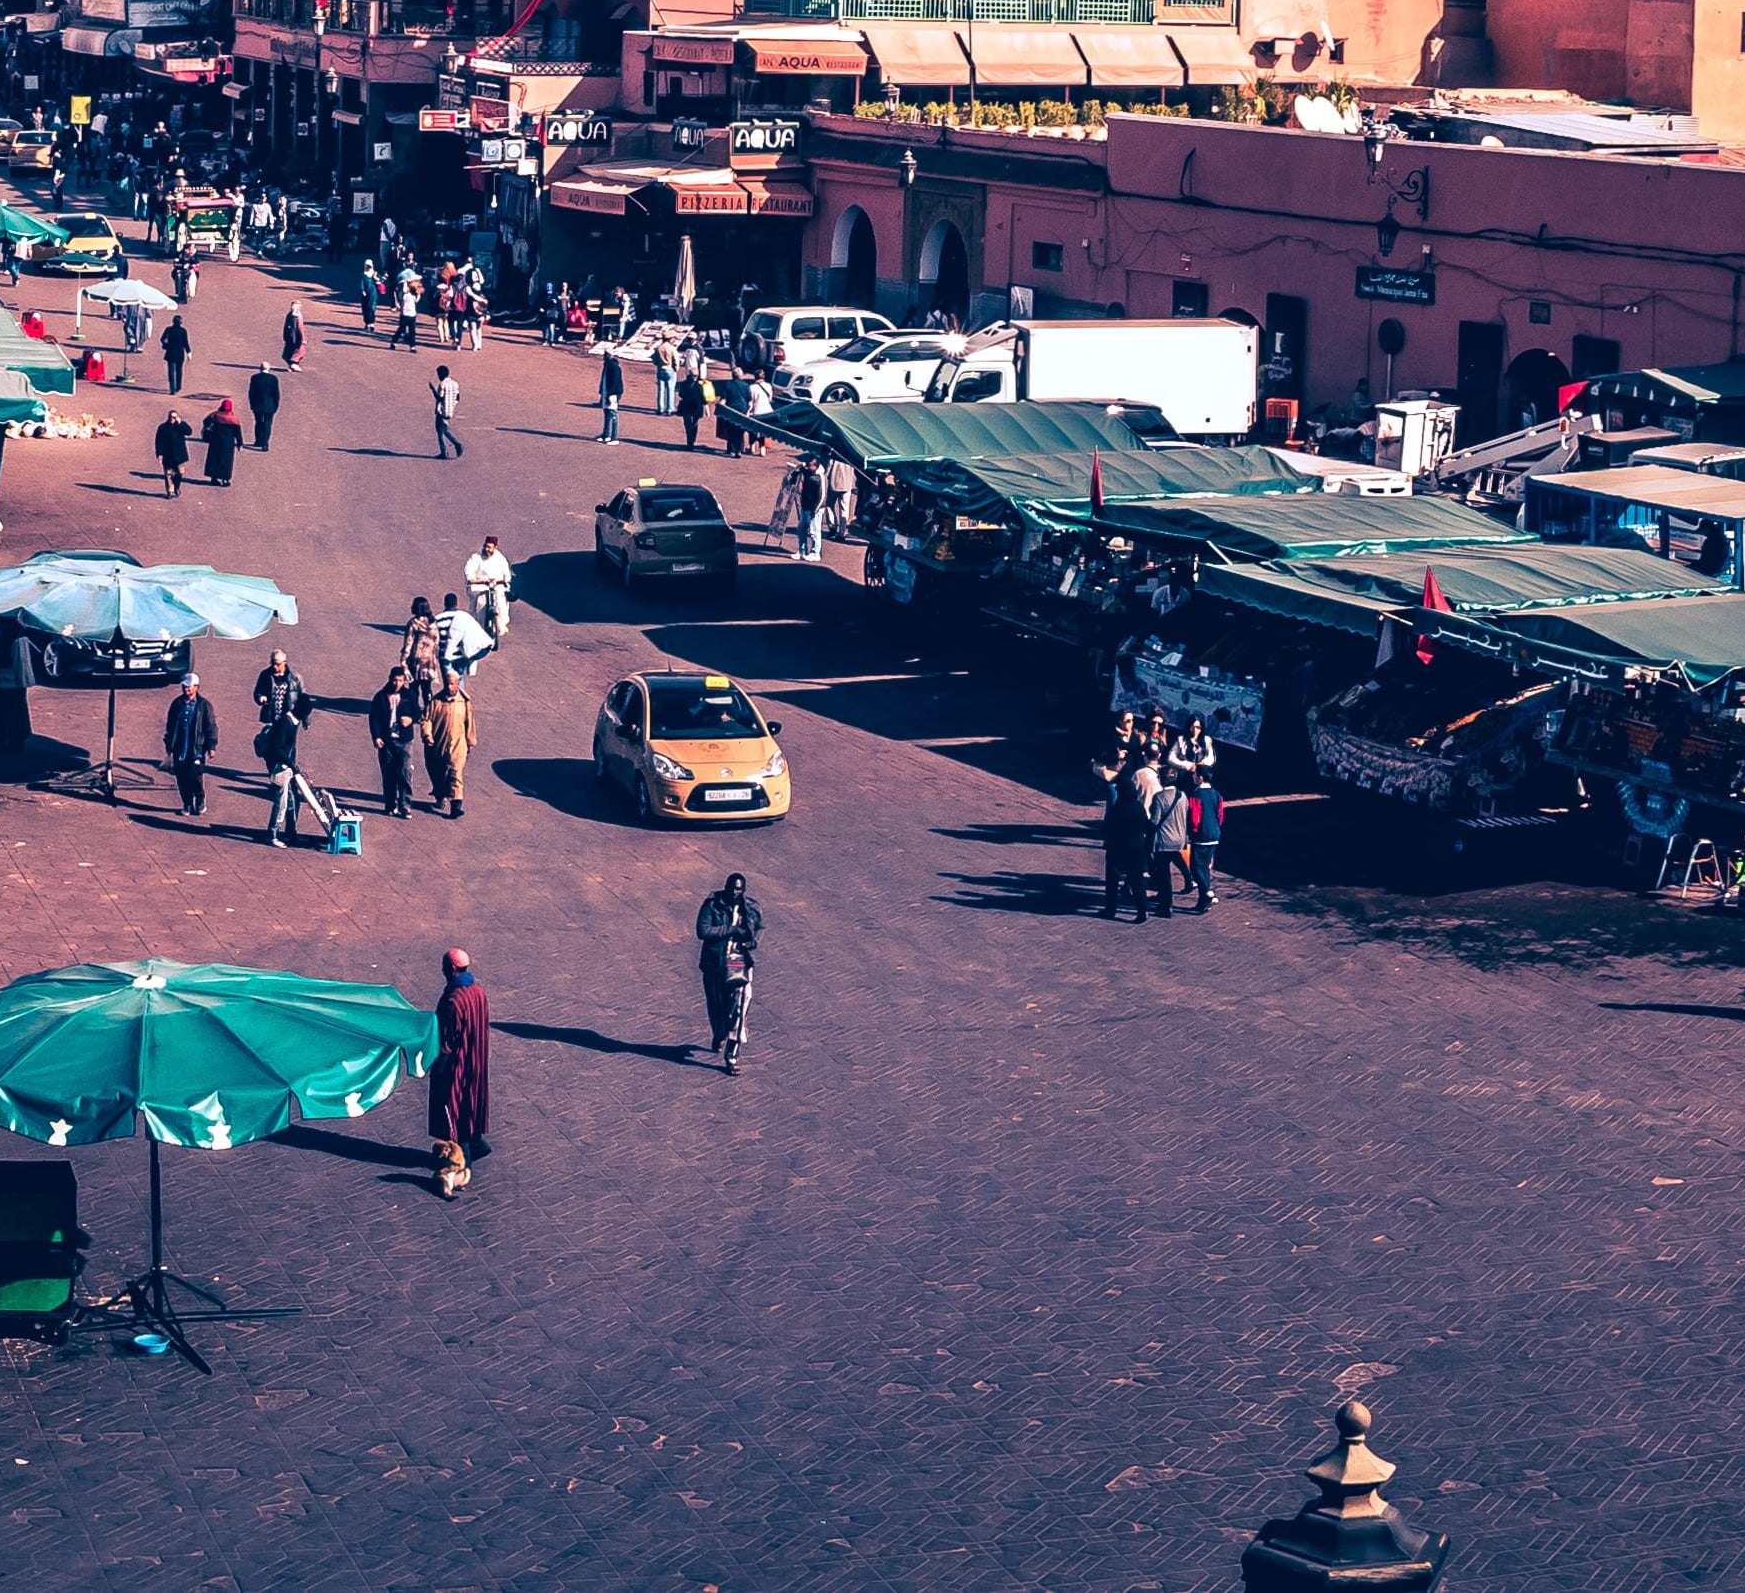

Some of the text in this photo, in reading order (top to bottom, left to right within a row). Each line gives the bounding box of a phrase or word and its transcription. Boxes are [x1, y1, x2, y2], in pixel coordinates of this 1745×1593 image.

[778, 57, 820, 69] AQUA
[547, 120, 607, 140] AQUA
[673, 125, 703, 145] AQUA
[734, 128, 794, 148] AQUA
[681, 196, 743, 211] PIZZERIA
[752, 198, 812, 213] RESTAURANT
